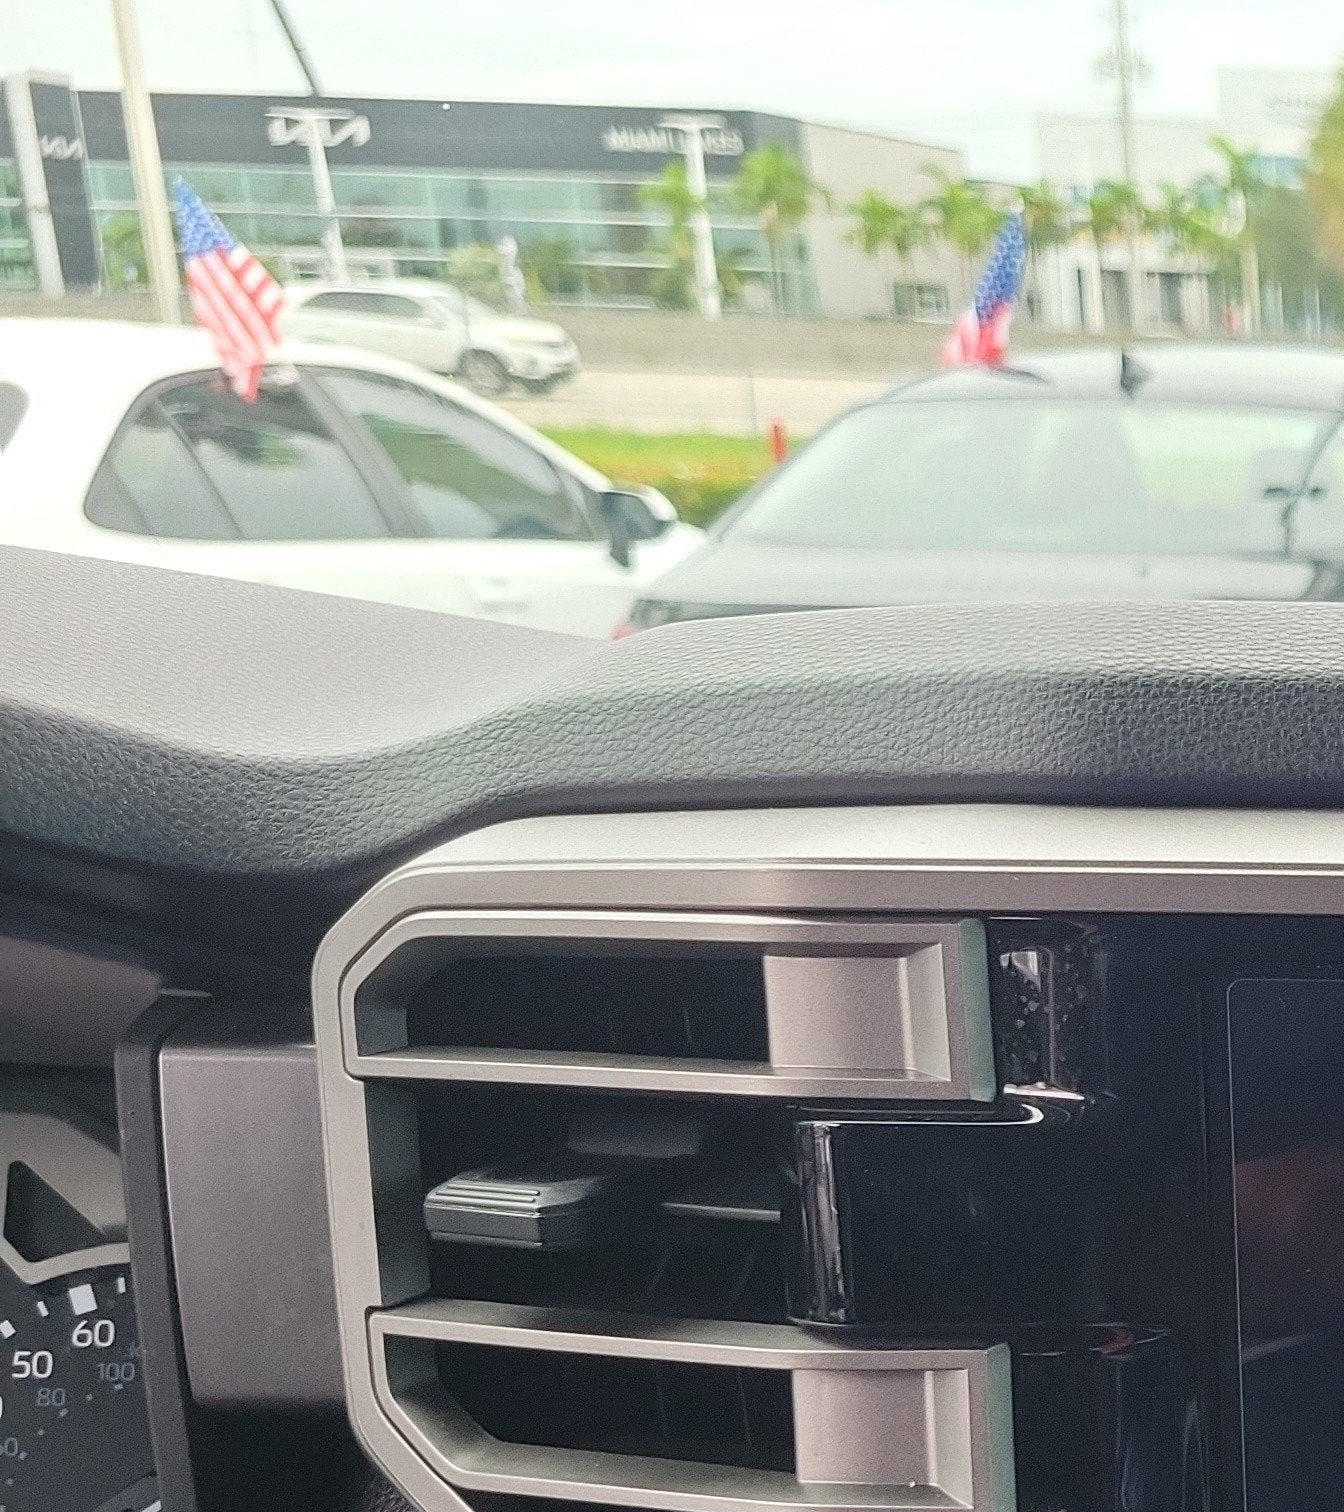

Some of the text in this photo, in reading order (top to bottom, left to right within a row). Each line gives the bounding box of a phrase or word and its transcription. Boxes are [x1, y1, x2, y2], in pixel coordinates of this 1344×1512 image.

[72, 1319, 116, 1348] 60
[11, 1350, 54, 1379] 50
[98, 1362, 136, 1382] 100
[37, 1387, 66, 1407] 80
